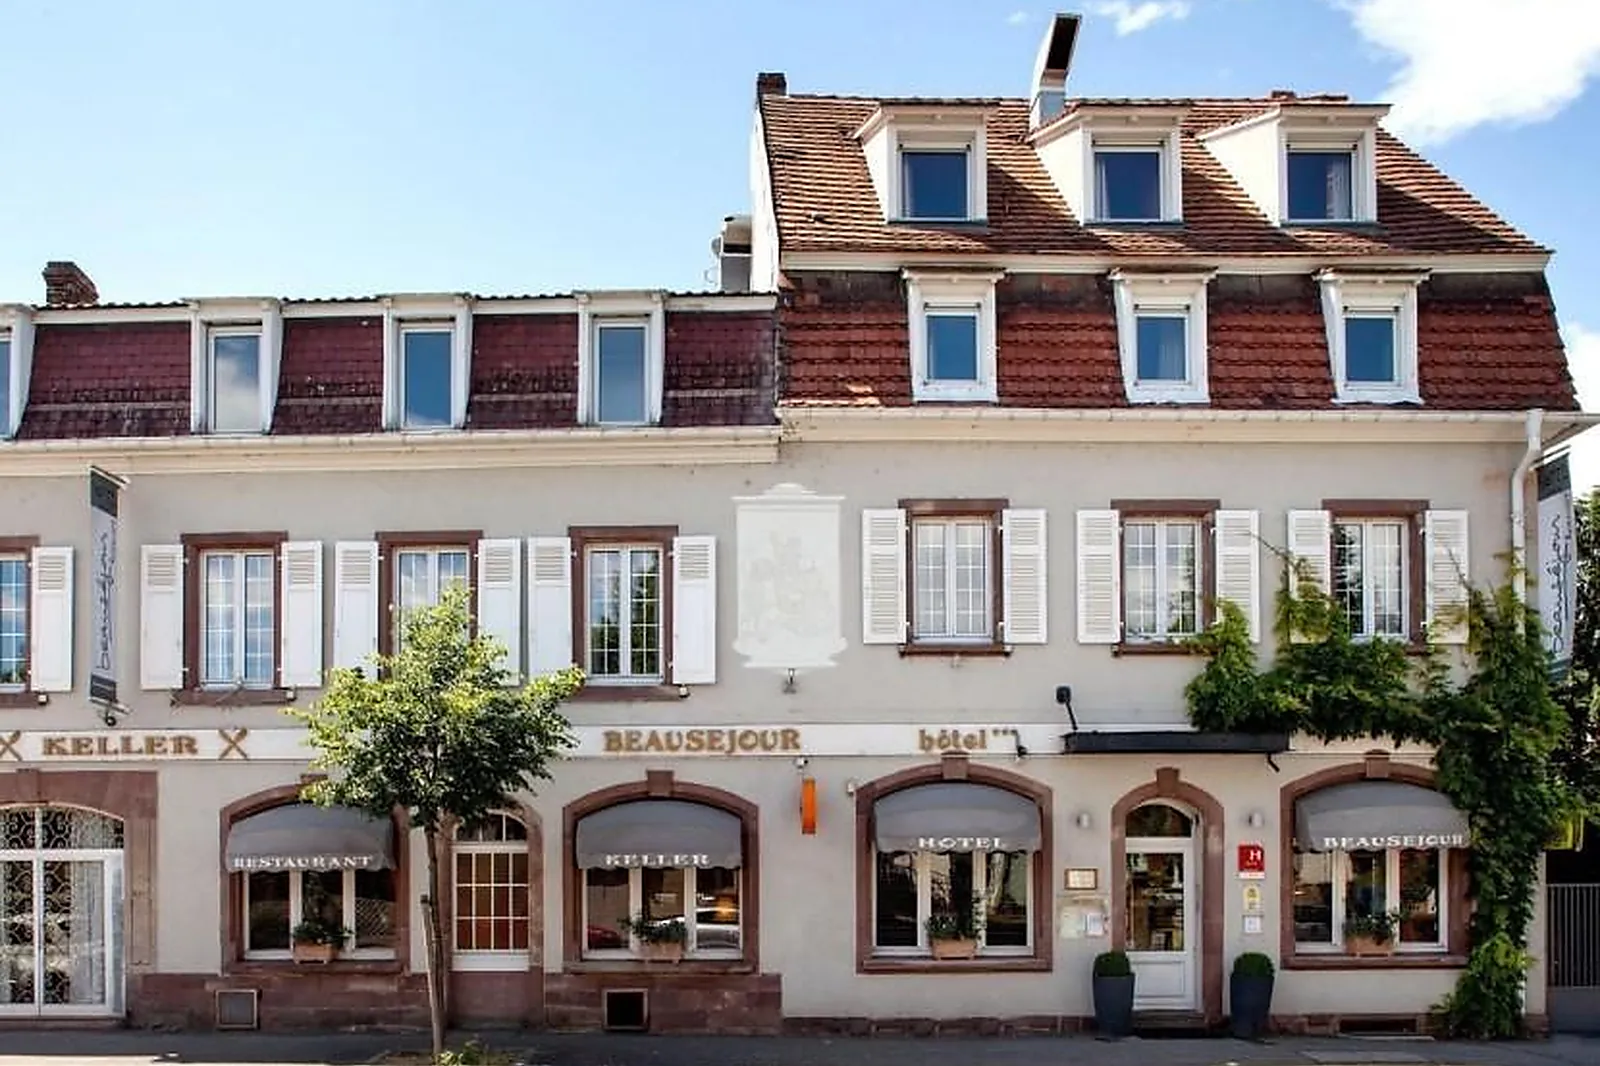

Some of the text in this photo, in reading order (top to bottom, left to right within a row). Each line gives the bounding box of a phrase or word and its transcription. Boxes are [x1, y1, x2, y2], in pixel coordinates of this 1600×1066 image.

[42, 735, 199, 756] KELLER
[603, 729, 800, 753] BEAUSEJOUR
[919, 729, 987, 751] hôtel
[918, 836, 1005, 850] HOTEL
[1323, 834, 1464, 849] BEAUSEJOUR
[234, 854, 373, 868] RESTAURANT
[605, 853, 709, 867] KELLER
[1250, 849, 1262, 861] H
